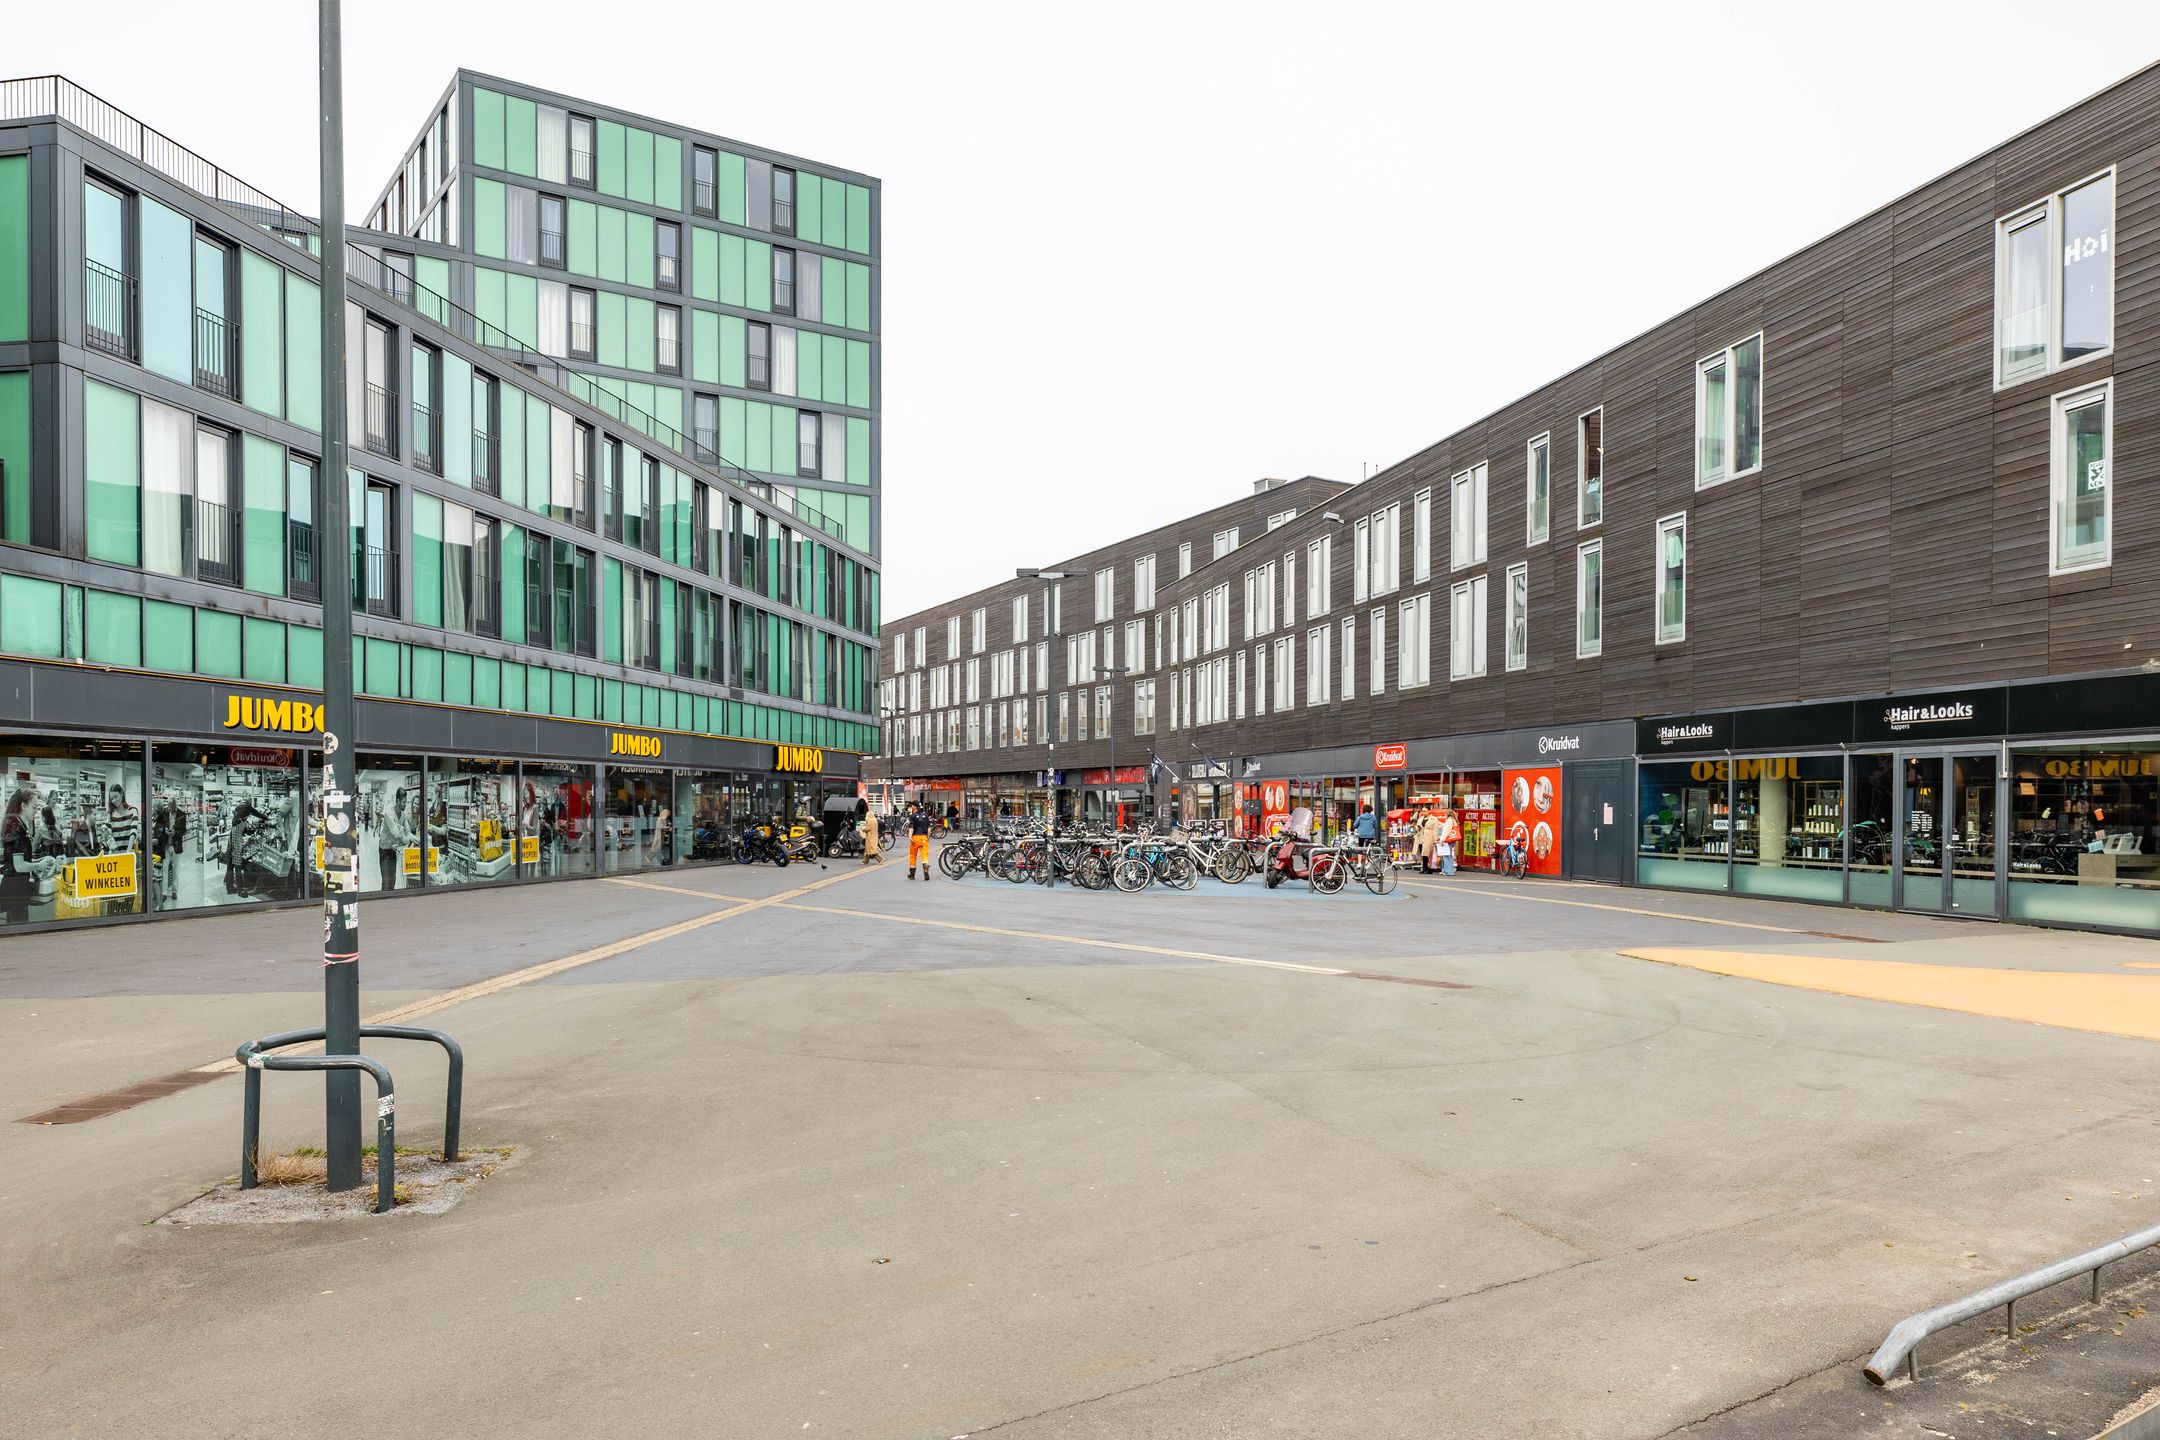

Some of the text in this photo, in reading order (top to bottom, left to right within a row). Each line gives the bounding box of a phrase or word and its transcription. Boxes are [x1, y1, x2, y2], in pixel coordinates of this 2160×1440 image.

[1891, 702, 1973, 722] Hair&Looks
[1661, 723, 1713, 738] Hair&Looks
[611, 733, 661, 758] JUMBO
[1548, 735, 1580, 751] Kruidvat
[775, 745, 823, 773] JUMBO
[96, 861, 118, 874] VLOT
[85, 876, 131, 890] WINKELEN
